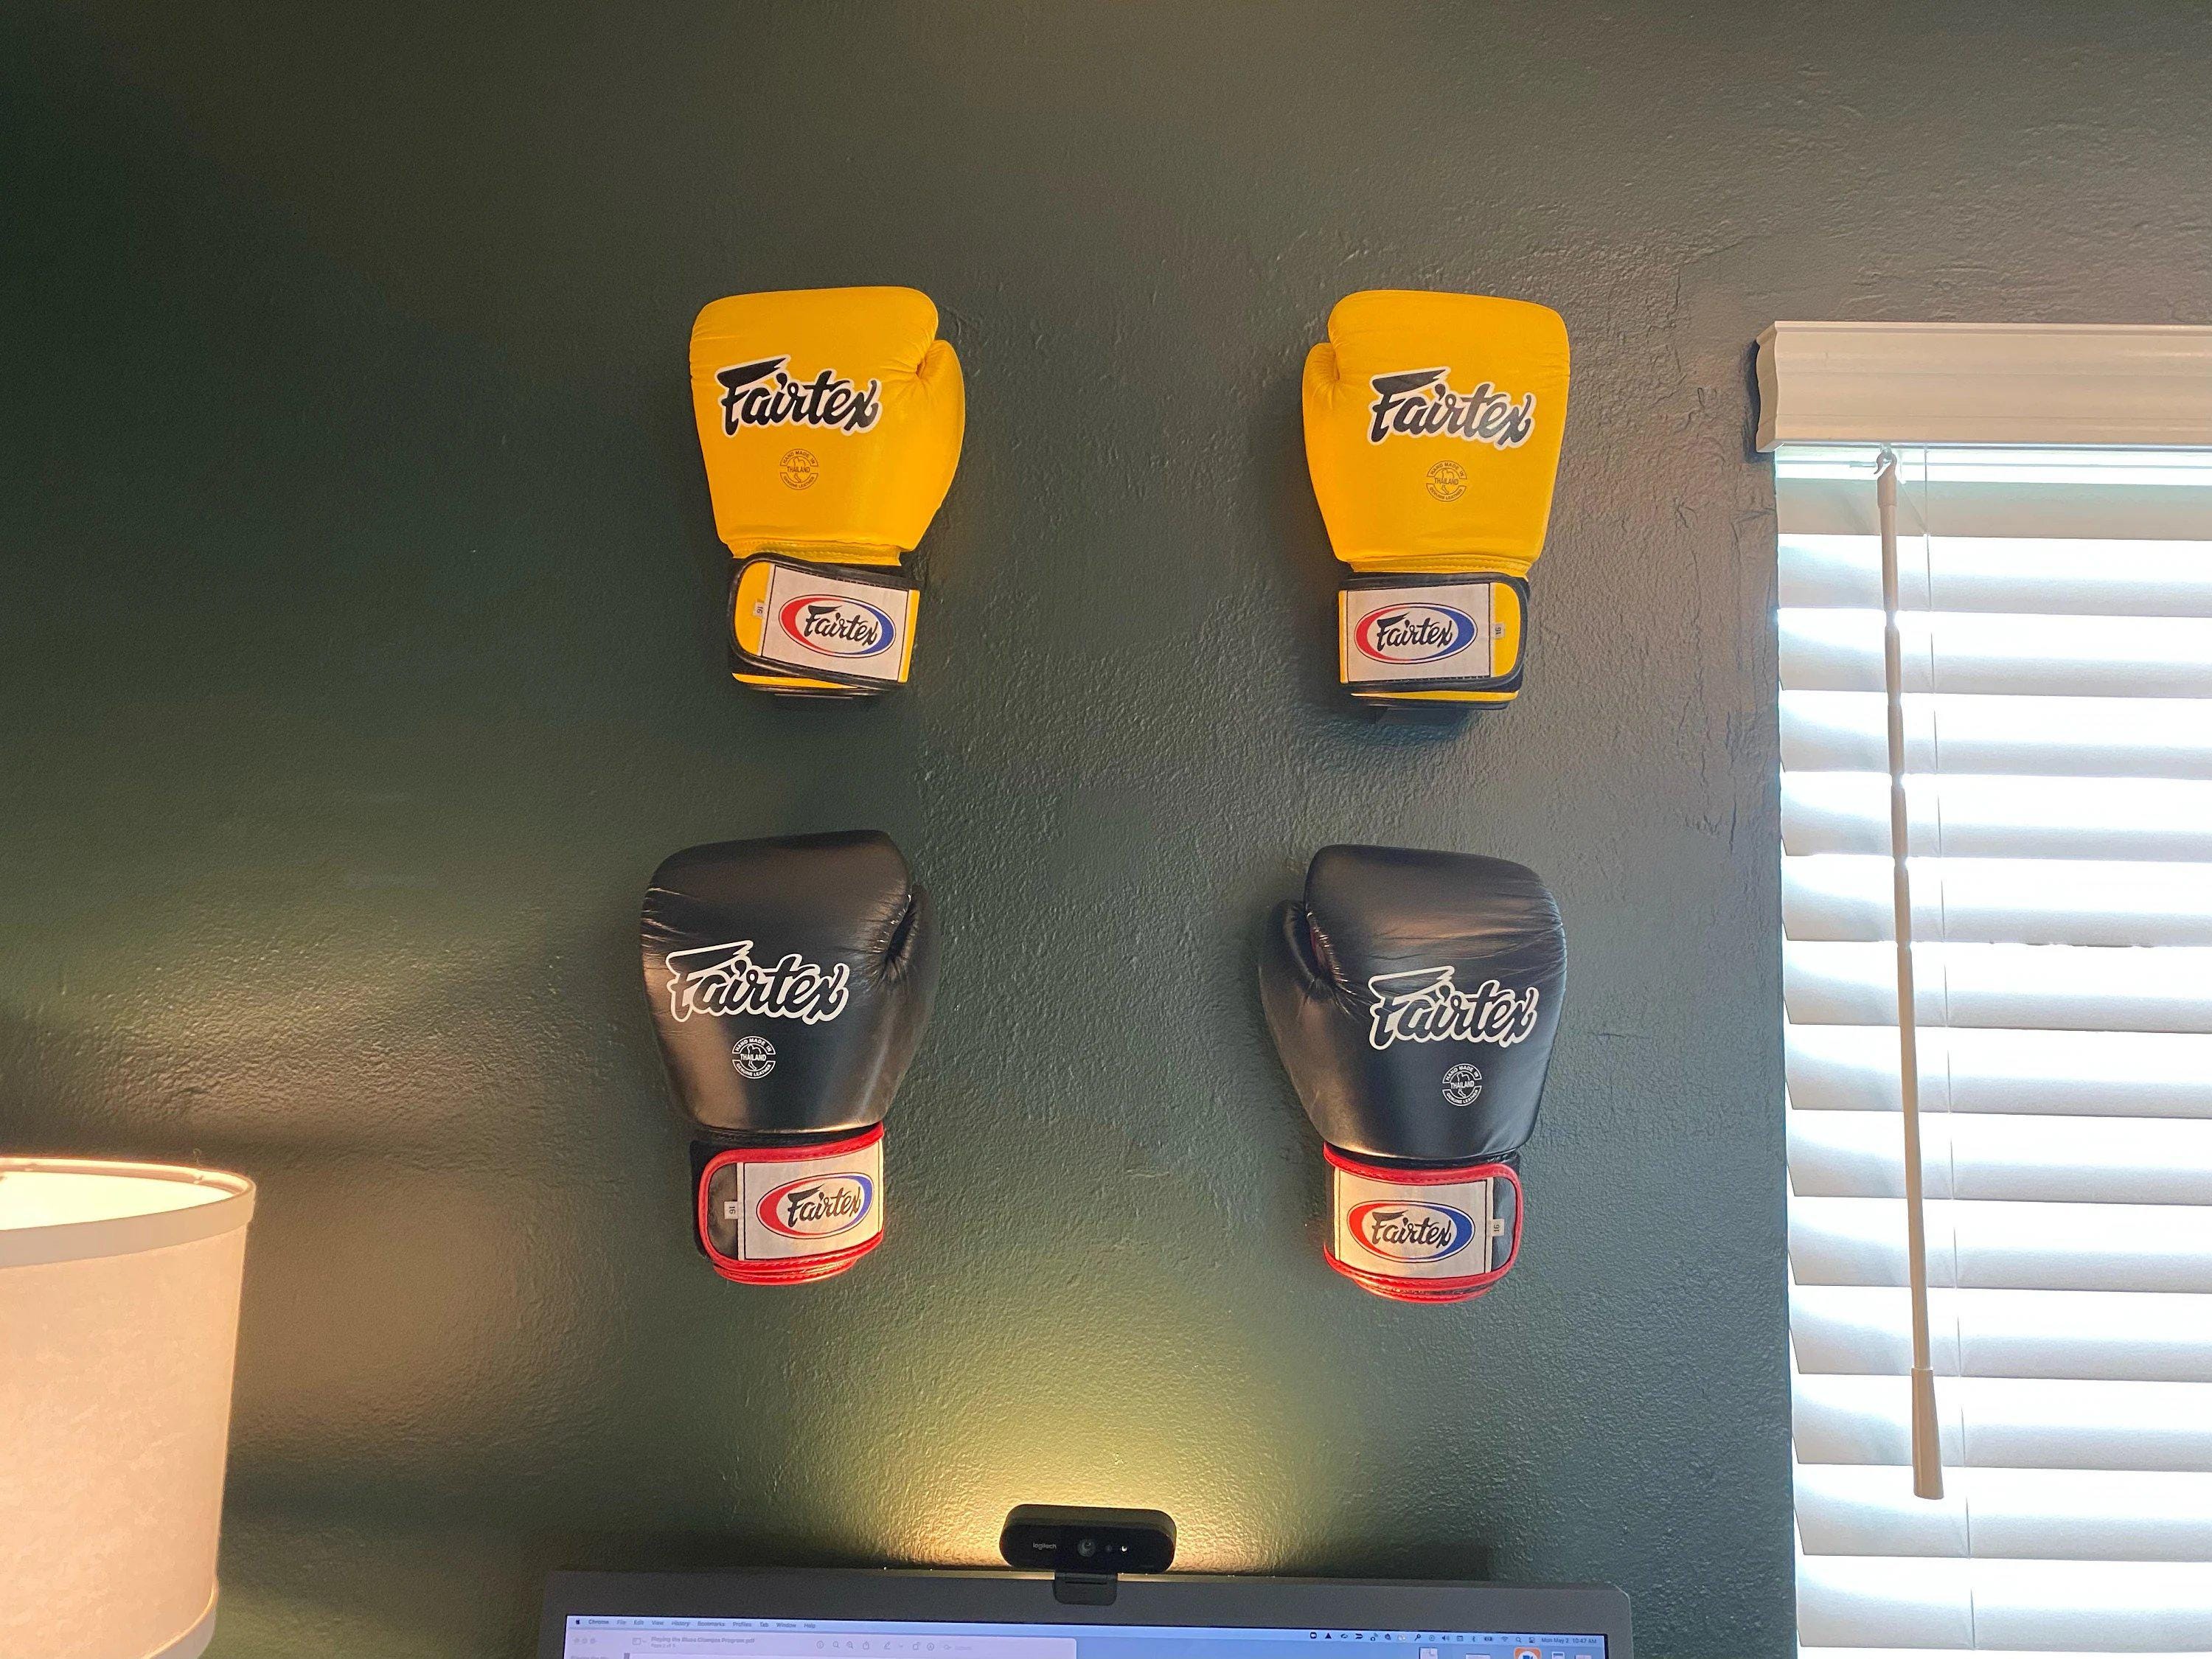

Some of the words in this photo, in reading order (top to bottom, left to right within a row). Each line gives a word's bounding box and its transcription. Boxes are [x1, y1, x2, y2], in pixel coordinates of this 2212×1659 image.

[716, 355, 881, 437] Fairtex
[1368, 367, 1537, 449] Fairtex
[783, 452, 794, 464] HAND
[1430, 463, 1443, 474] HAND
[1444, 462, 1459, 470] MADE
[1434, 477, 1459, 485] THAILAND
[804, 605, 878, 646] Fairtex
[1495, 627, 1501, 635] 16
[1377, 613, 1453, 651] Fairtex
[667, 940, 850, 1025] Fairtex
[1368, 965, 1539, 1049] Fairtex
[735, 1040, 748, 1051] HAND
[1446, 1068, 1458, 1081] HAND
[1450, 1080, 1475, 1089] THAILAND
[728, 1206, 736, 1214] 16
[787, 1183, 862, 1227] Fairtex
[1371, 1210, 1452, 1248] Fairtex
[1493, 1224, 1500, 1232] 16
[1032, 1542, 1057, 1550] logitech
